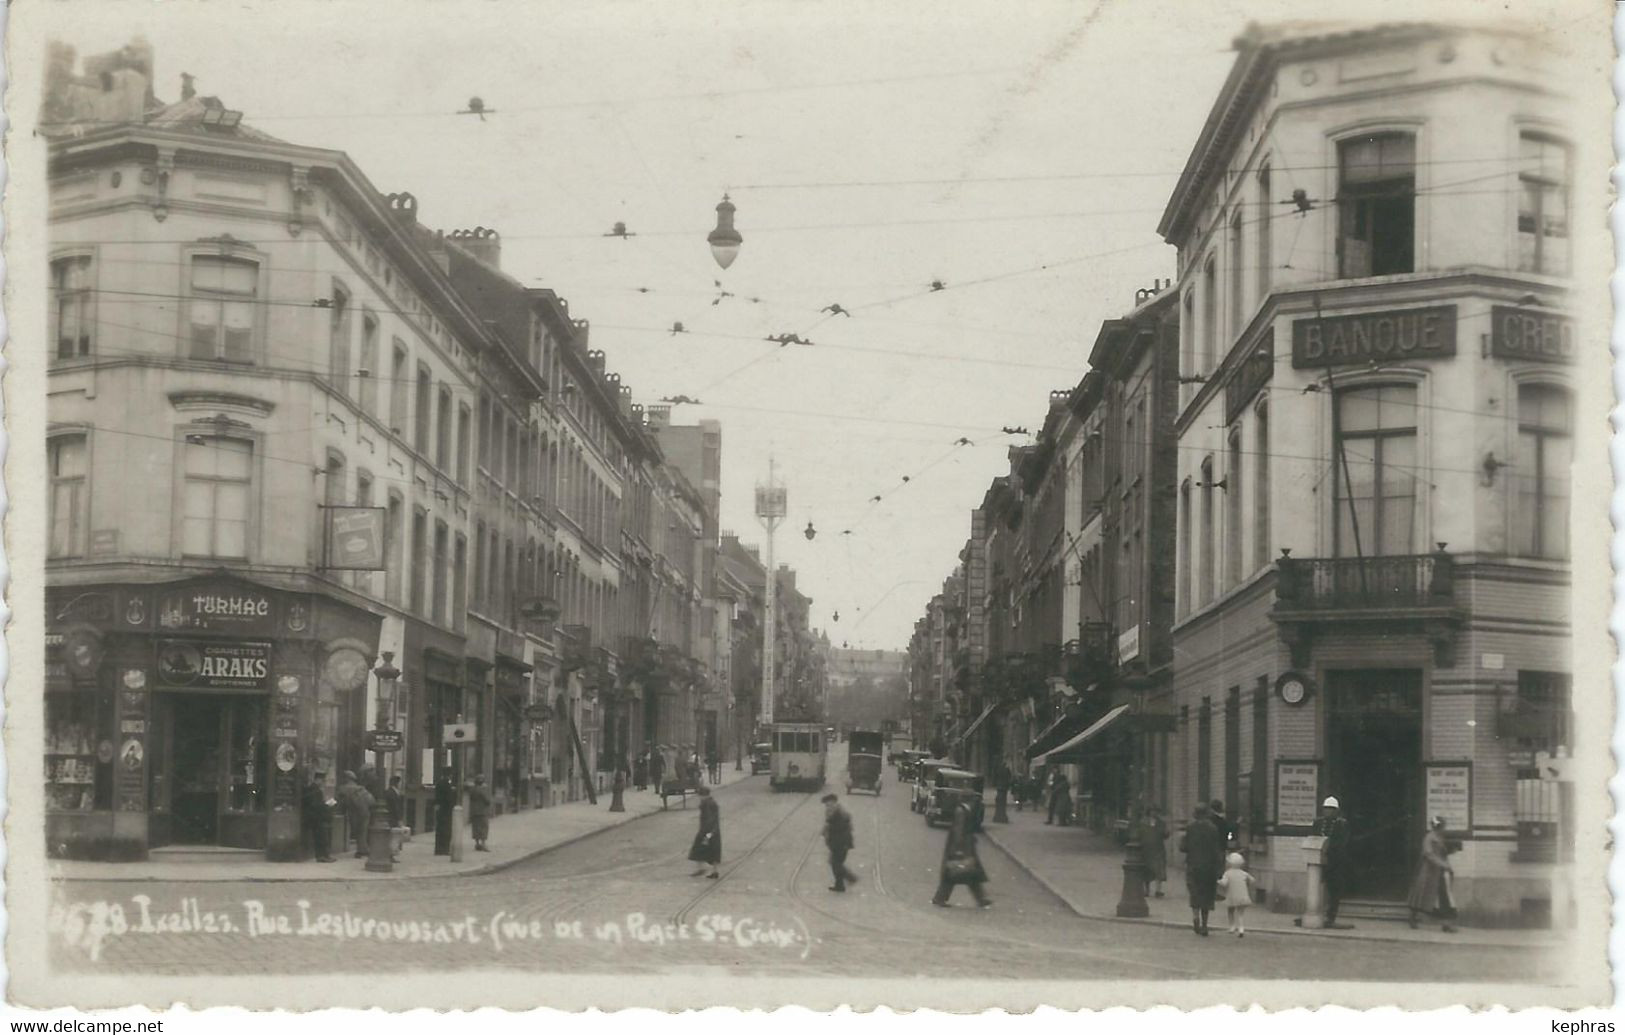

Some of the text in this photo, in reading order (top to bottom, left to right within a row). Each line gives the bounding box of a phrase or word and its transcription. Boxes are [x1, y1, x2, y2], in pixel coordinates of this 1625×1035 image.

[1304, 311, 1442, 360] BANQUE
[193, 595, 269, 616] TURMAC
[205, 647, 265, 656] CIGARETTES
[201, 657, 267, 679] ARAKS
[244, 900, 292, 937] Rue
